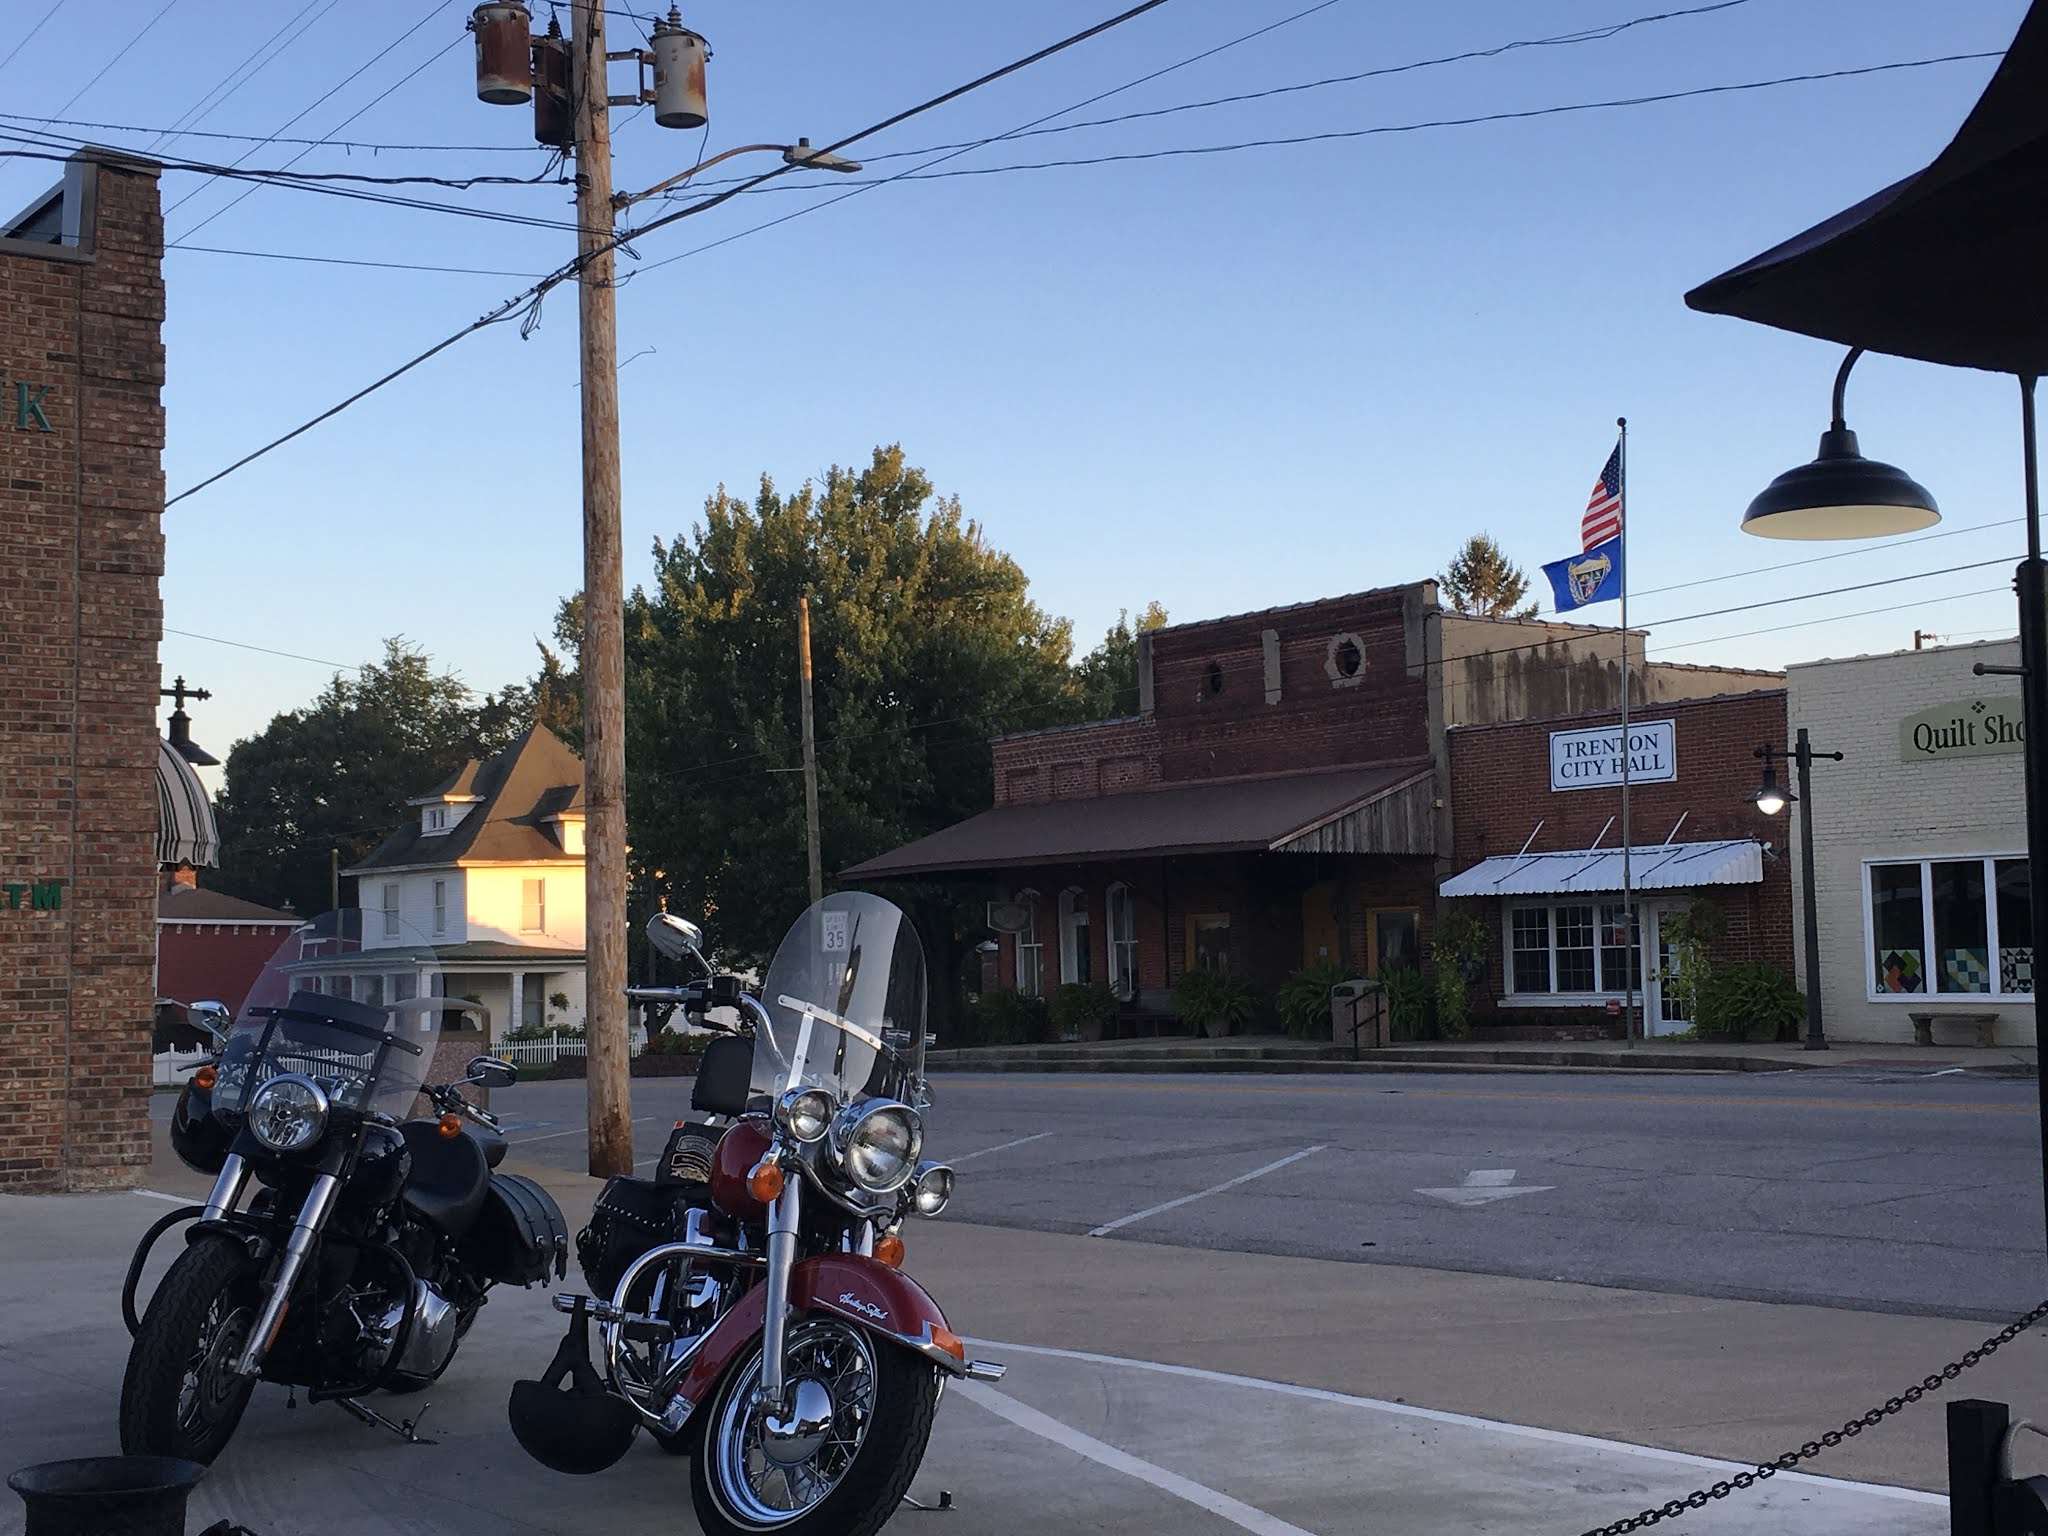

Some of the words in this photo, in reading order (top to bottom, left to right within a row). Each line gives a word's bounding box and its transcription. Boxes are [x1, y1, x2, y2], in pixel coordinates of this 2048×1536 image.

[1563, 733, 1659, 758] TRENTON
[1913, 718, 1976, 754] Quilt
[1561, 760, 1605, 778] CITY
[1611, 754, 1665, 774] HALL
[0, 884, 62, 910] TM
[827, 930, 844, 949] 35
